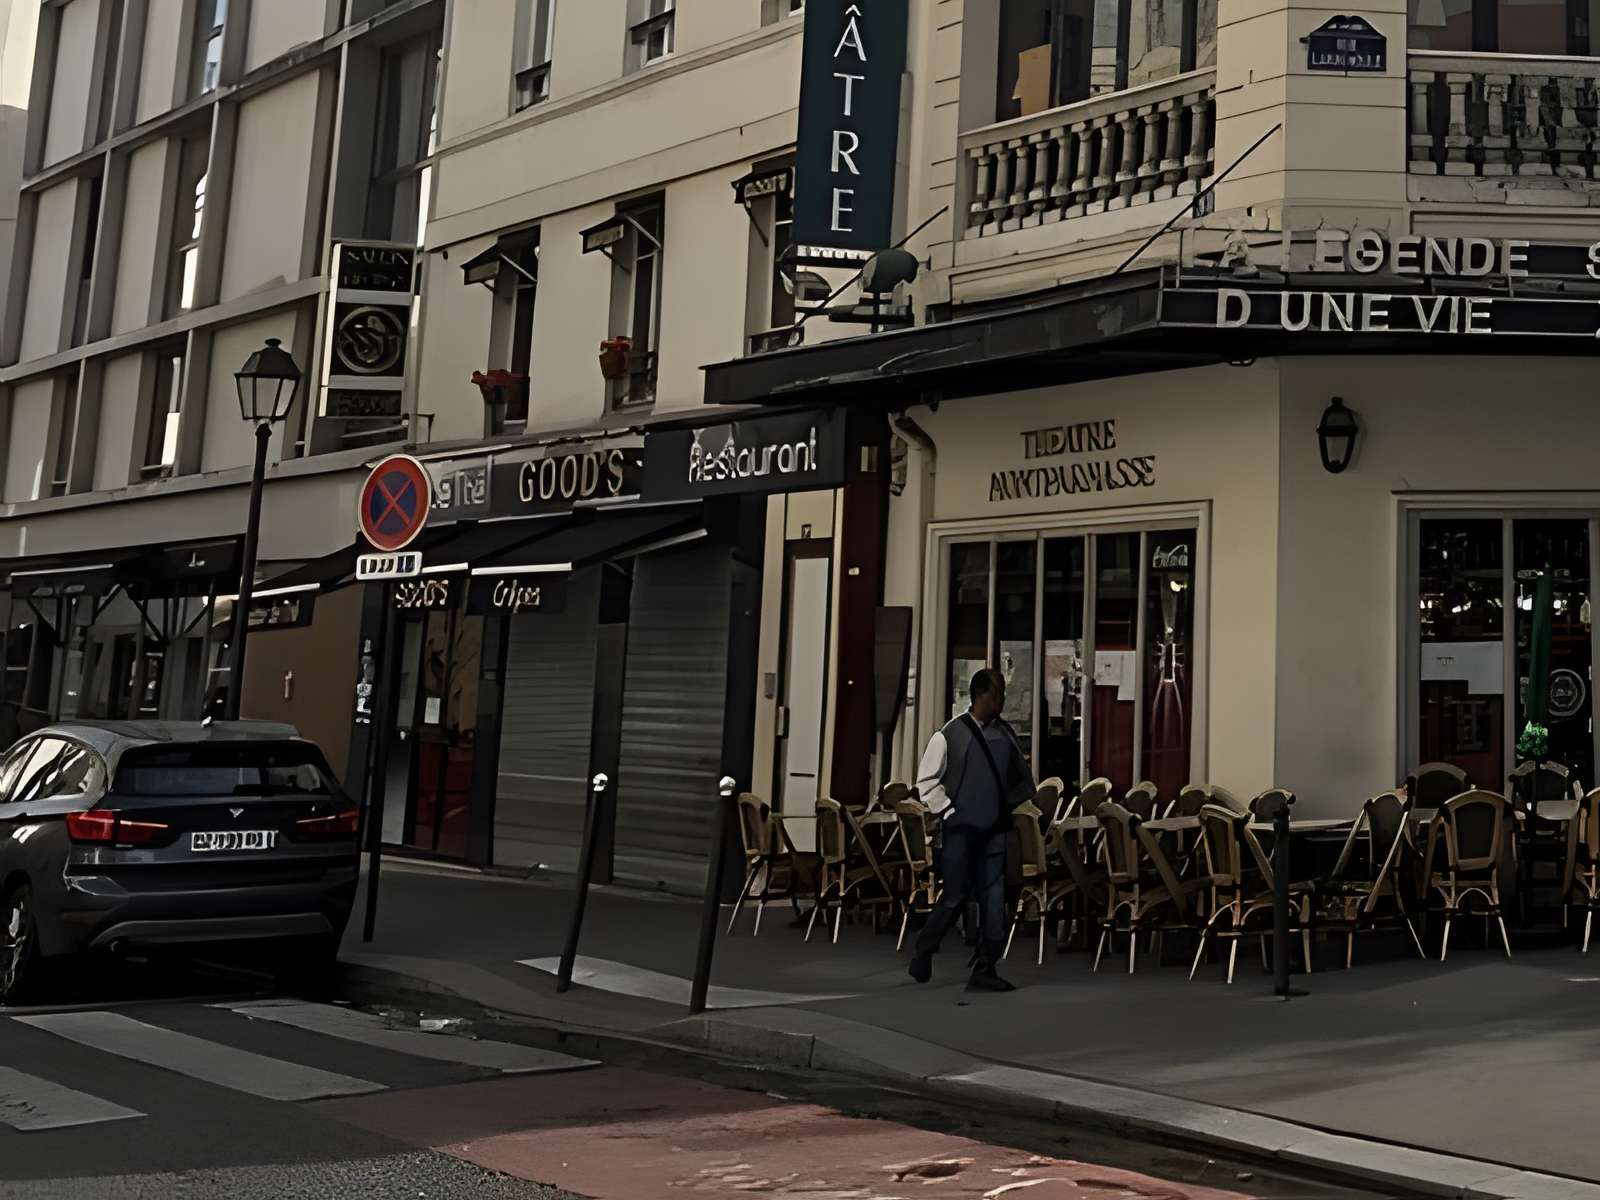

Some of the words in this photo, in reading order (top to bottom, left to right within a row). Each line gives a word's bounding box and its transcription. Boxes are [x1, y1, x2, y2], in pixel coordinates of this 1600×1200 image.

[1280, 292, 1393, 333] UNE
[1412, 296, 1494, 334] VIE
[518, 448, 625, 502] GOOD'S
[689, 427, 817, 483] Restaurant
